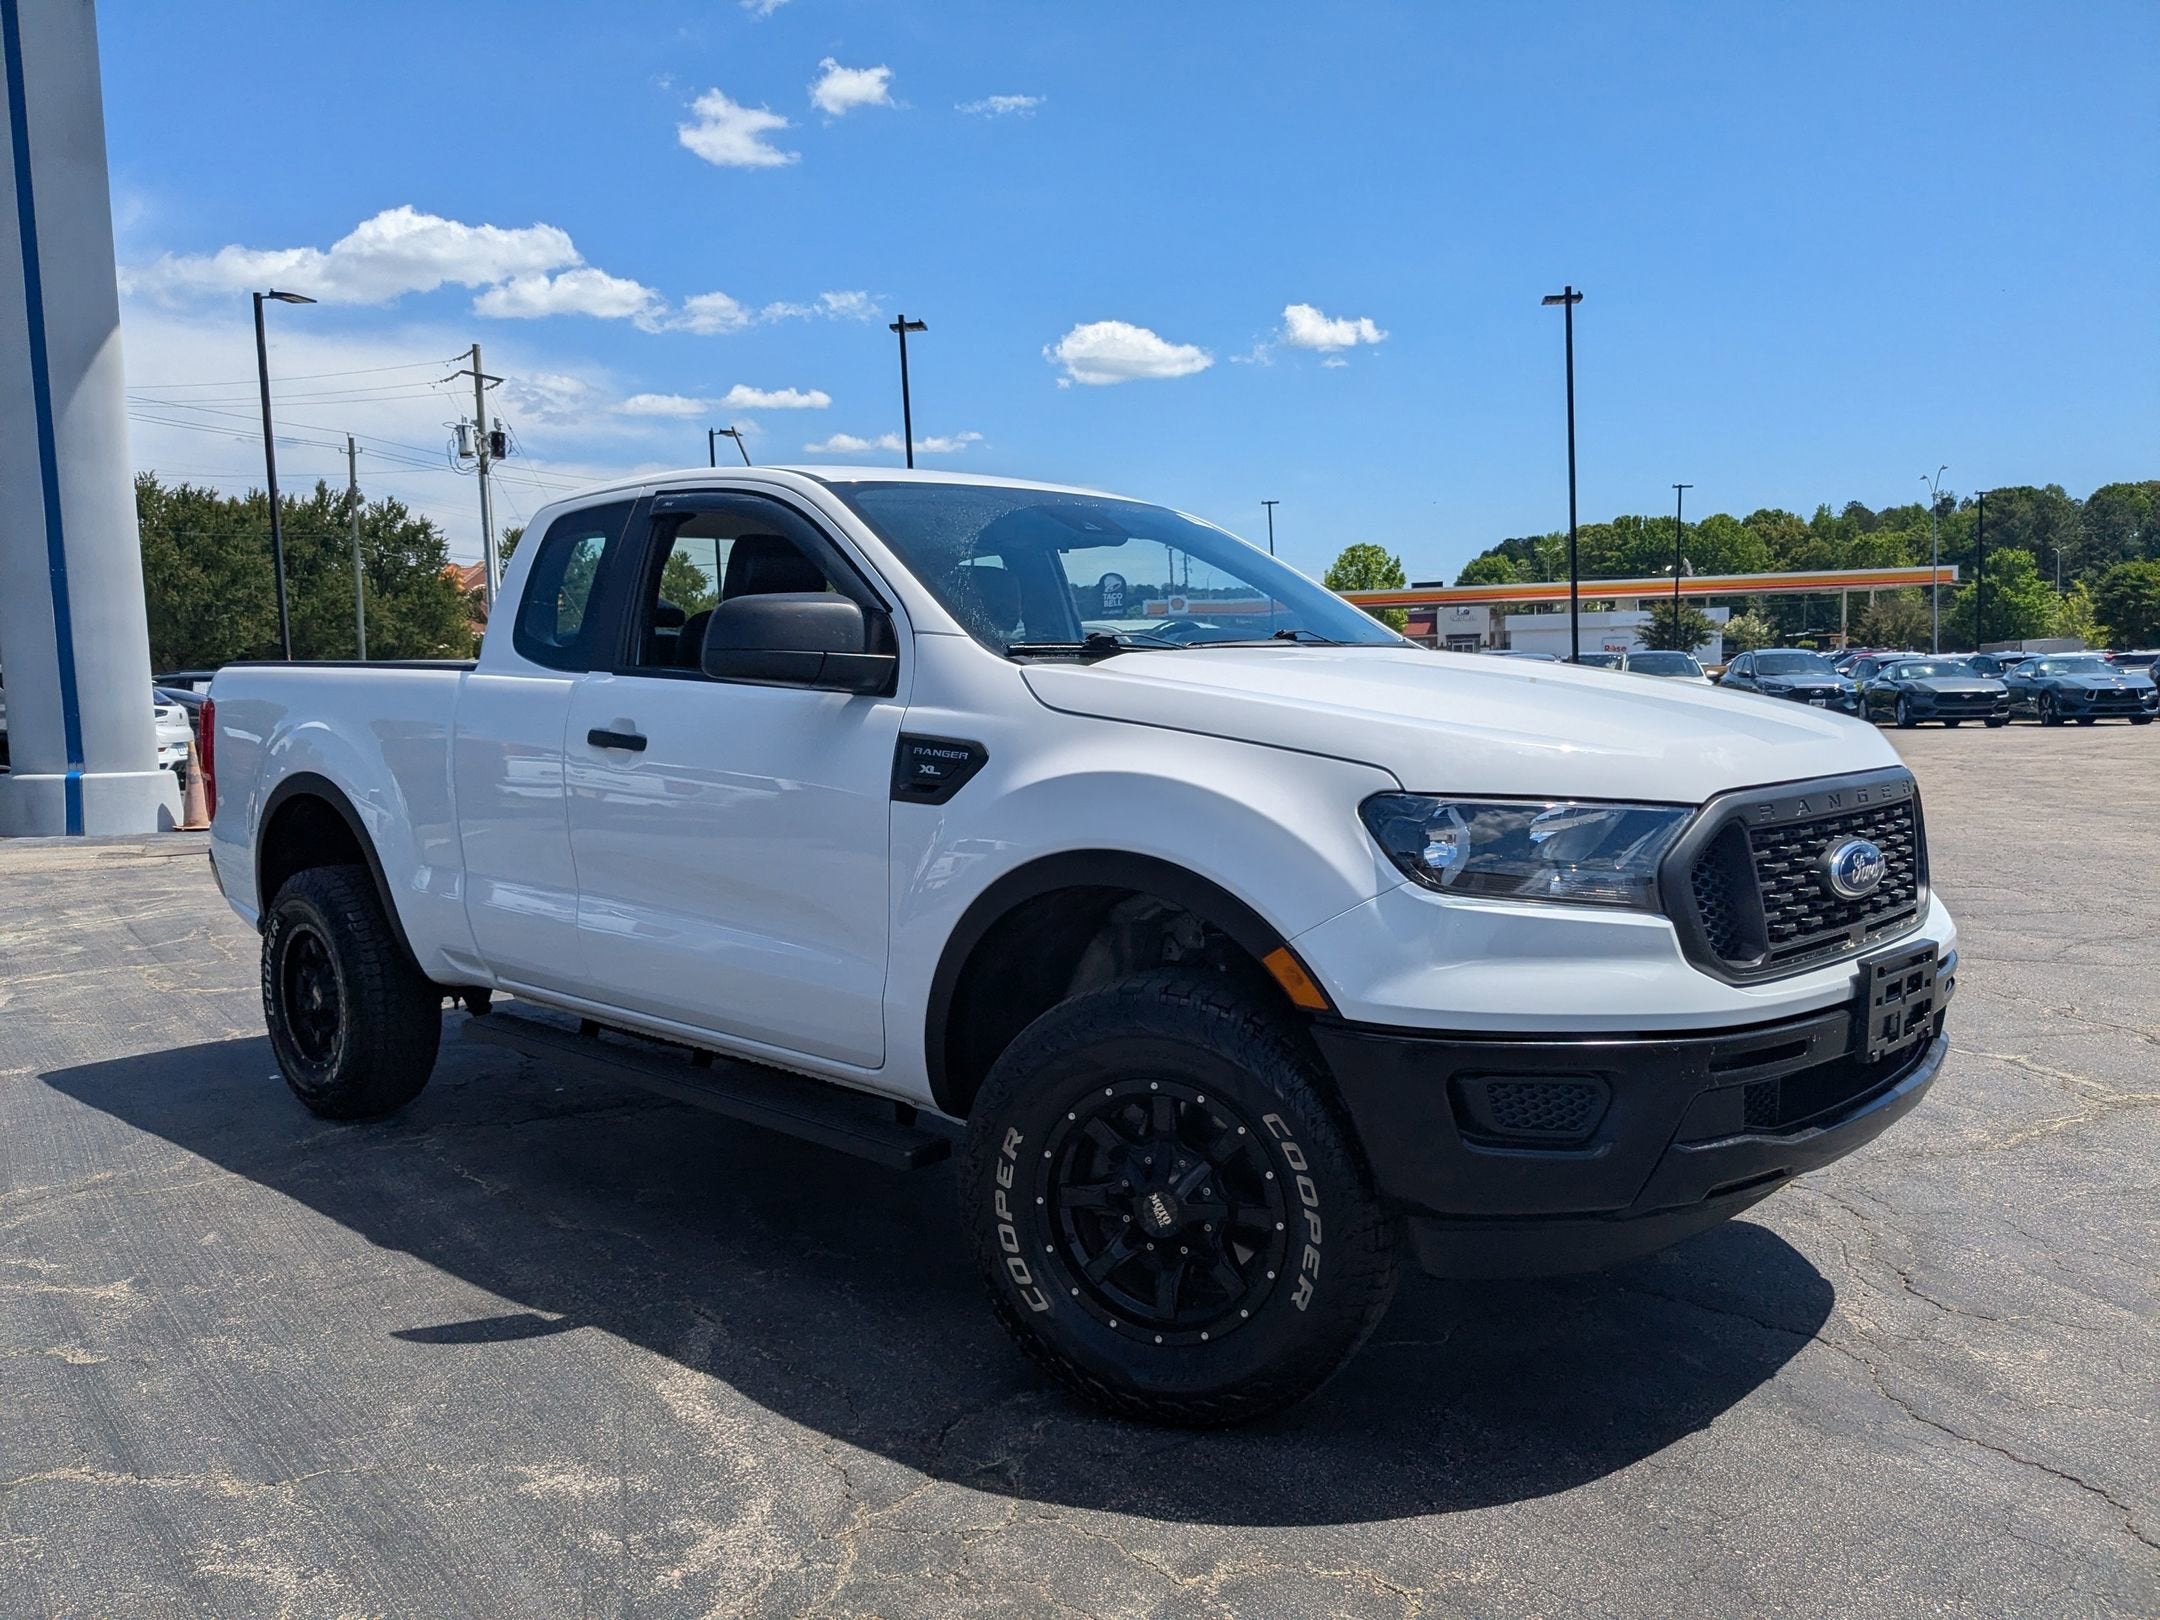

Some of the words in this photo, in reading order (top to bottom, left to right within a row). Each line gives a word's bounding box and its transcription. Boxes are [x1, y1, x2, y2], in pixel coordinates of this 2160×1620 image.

[1103, 600, 1122, 608] BELL
[913, 747, 969, 760] RANGER
[919, 764, 942, 775] XL
[1758, 779, 1912, 822] RANGER
[1852, 852, 1880, 884] Ford
[265, 919, 280, 1016] COOPER
[994, 1126, 1049, 1312] COOPER
[1149, 1192, 1172, 1225] MOTO
[1262, 1113, 1322, 1312] COOPER
